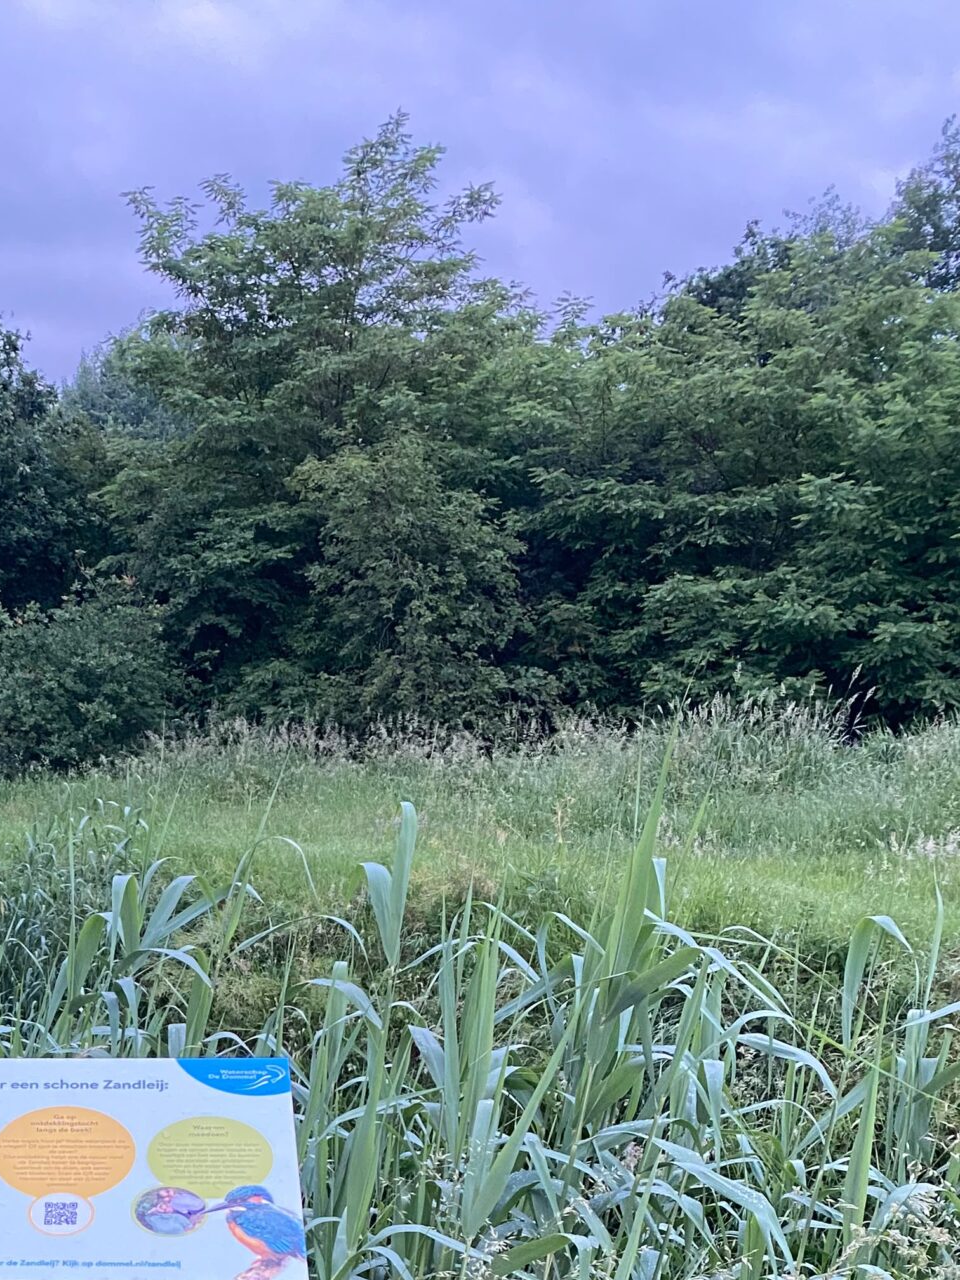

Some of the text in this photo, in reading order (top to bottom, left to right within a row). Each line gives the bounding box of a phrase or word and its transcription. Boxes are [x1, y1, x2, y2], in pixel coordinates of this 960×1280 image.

[10, 1081, 39, 1090] een
[43, 1079, 99, 1090] schone
[102, 1079, 169, 1092] Zandleij:
[19, 1259, 60, 1268] Zandleij?
[61, 1259, 80, 1268] Kijk
[81, 1260, 93, 1268] op
